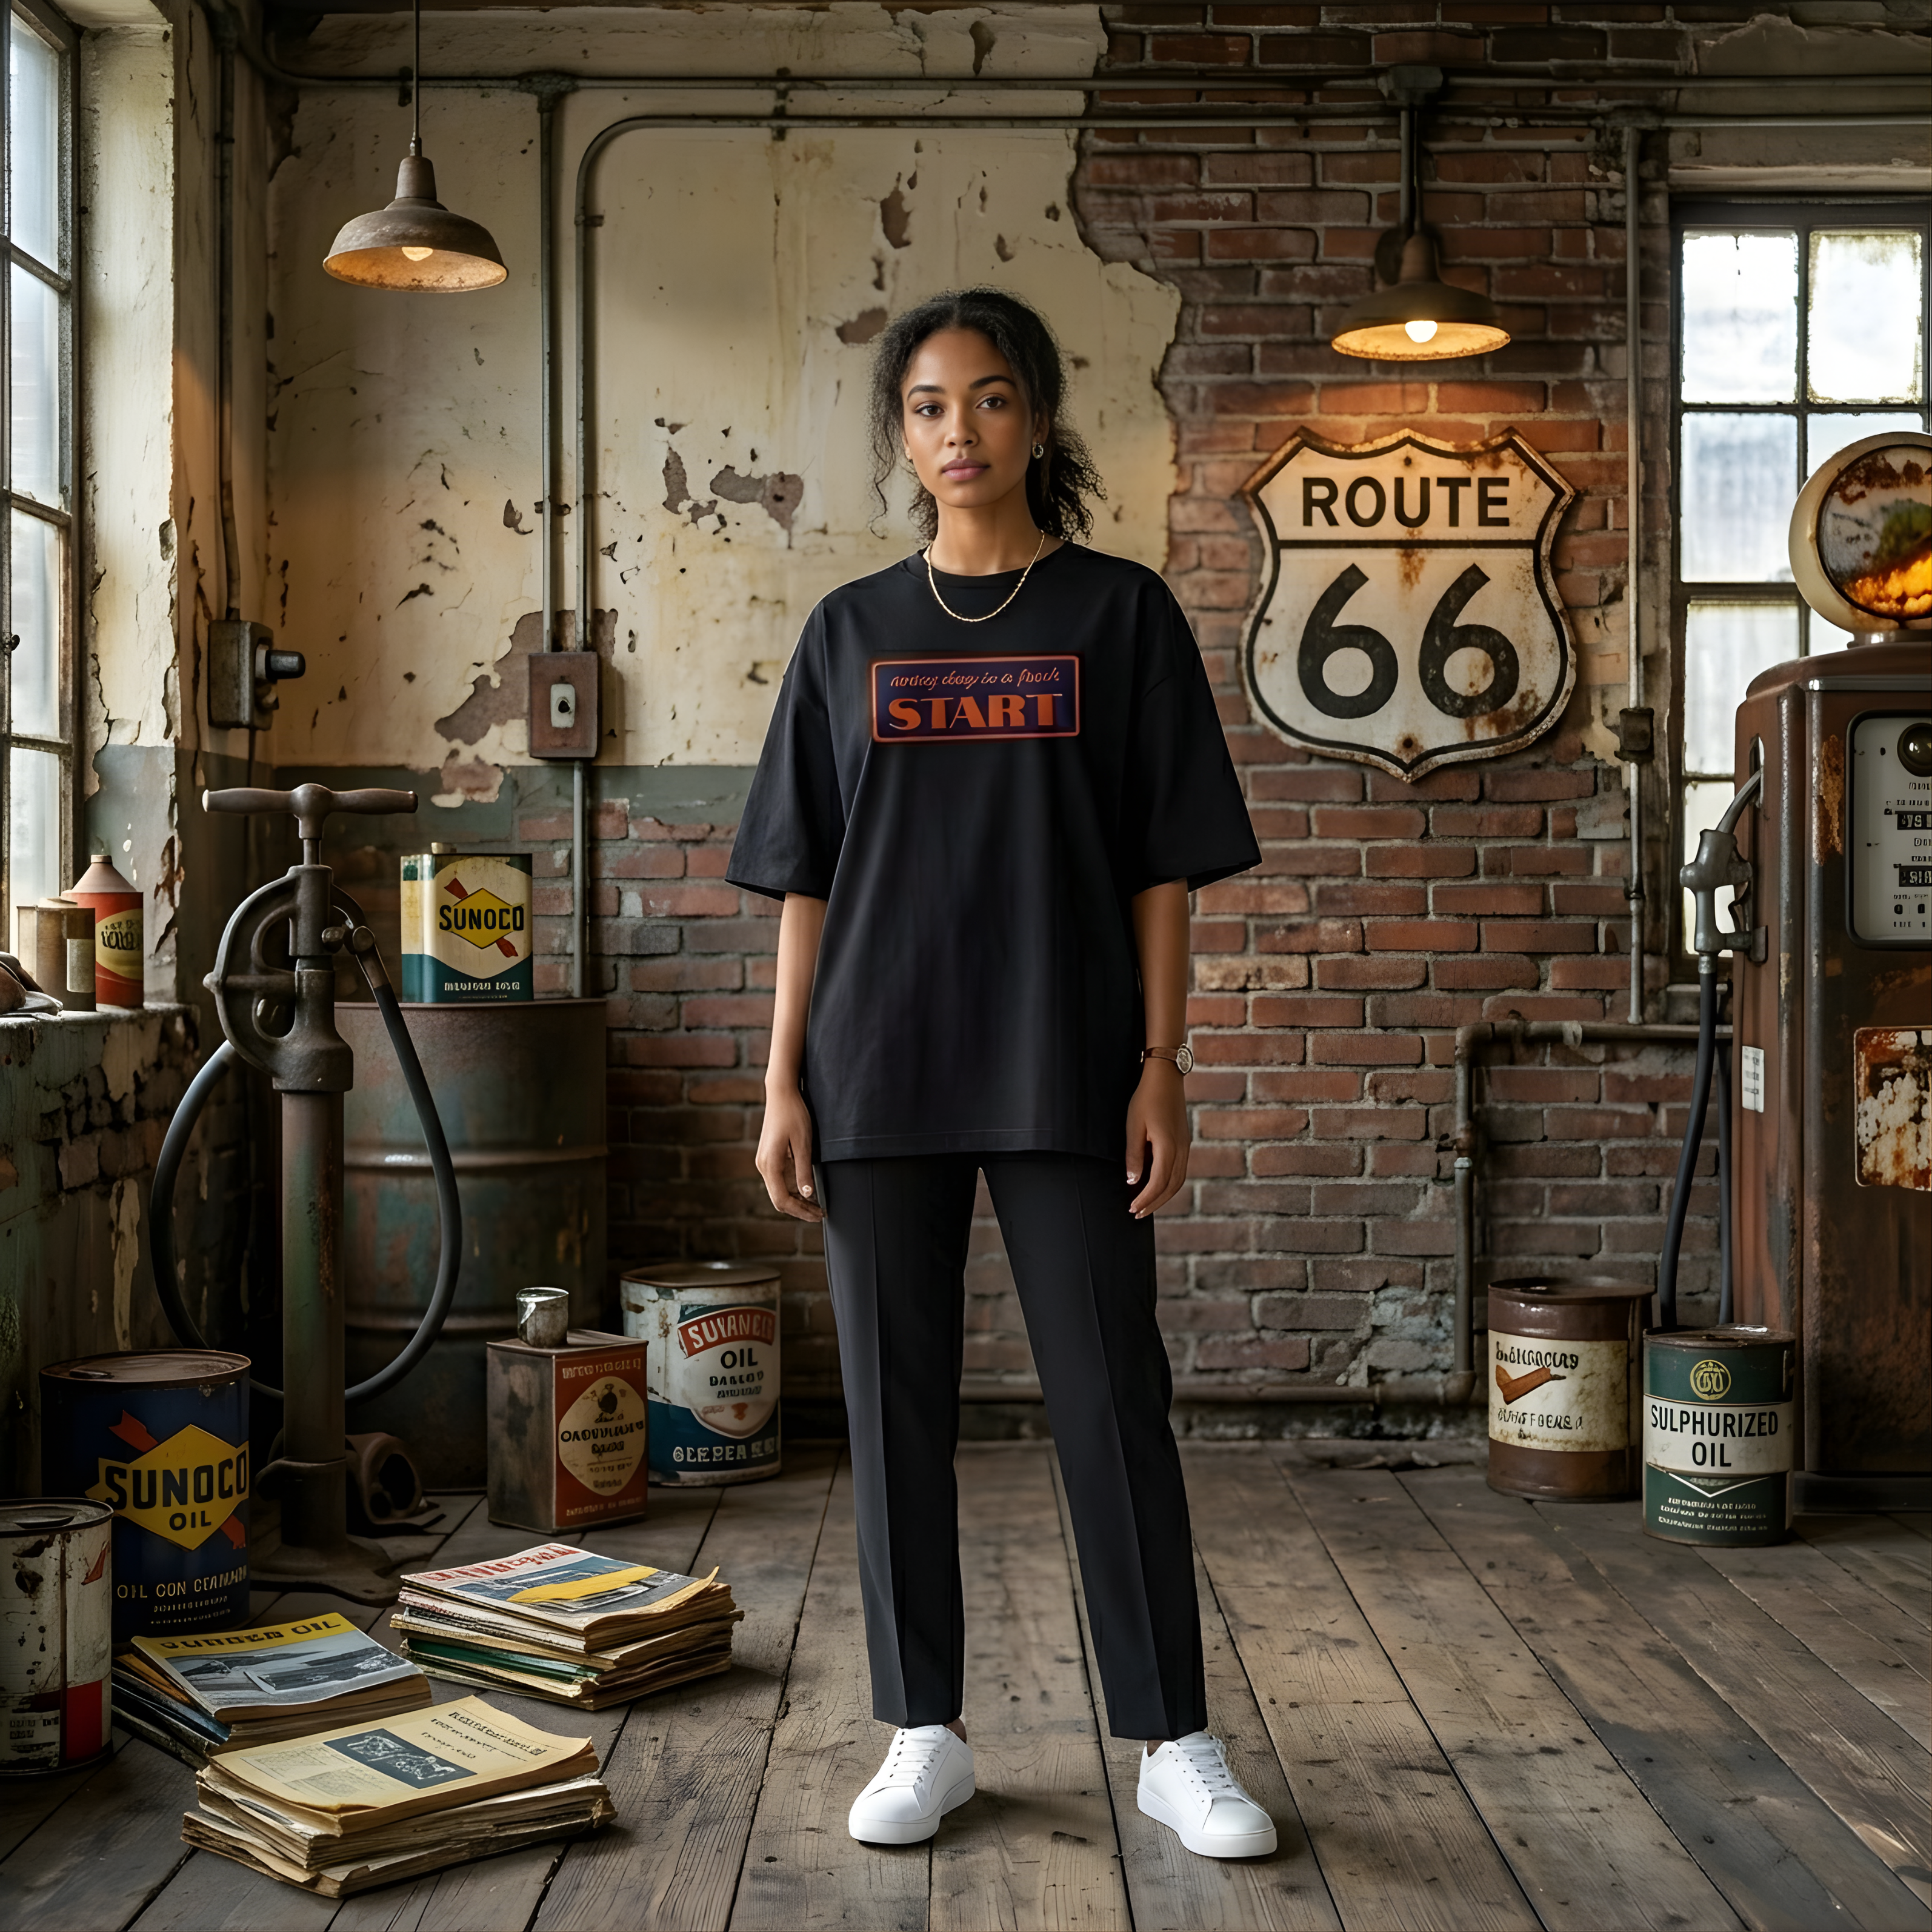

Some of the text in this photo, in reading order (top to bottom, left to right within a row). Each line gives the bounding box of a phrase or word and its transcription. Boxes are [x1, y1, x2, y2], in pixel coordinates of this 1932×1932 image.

[1302, 476, 1510, 528] ROUTE
[1297, 562, 1520, 719] 66
[888, 693, 1063, 731] START
[439, 904, 524, 931] SUNOCO
[720, 1347, 759, 1370] OIL
[1651, 1404, 1779, 1437] SULPHURIZED
[1691, 1441, 1732, 1467] OIL
[105, 1449, 247, 1510] SUNOCO
[168, 1510, 212, 1531] OIL
[117, 1584, 148, 1599] OIL
[290, 1620, 342, 1635] OIL
